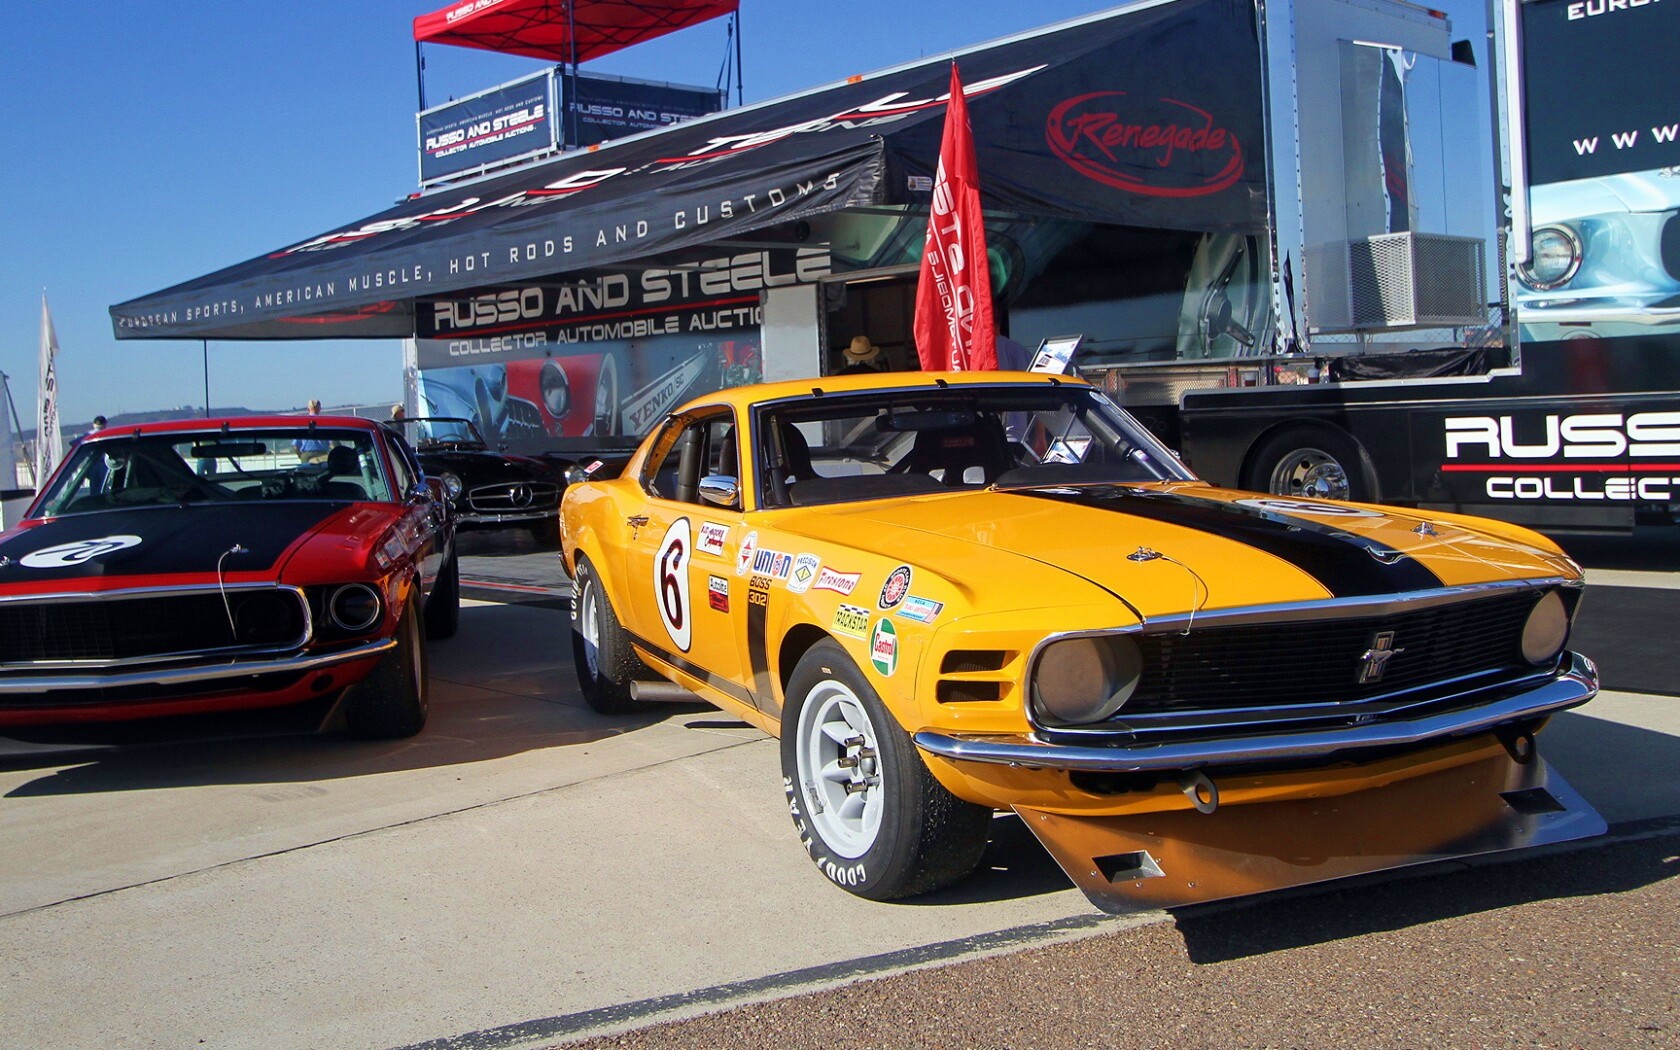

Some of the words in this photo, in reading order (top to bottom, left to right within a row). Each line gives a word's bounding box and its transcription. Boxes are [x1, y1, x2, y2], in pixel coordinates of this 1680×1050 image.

[570, 102, 623, 117] RUSSO
[627, 109, 657, 121] AND
[426, 129, 465, 150] RUSSO
[467, 121, 491, 140] AND
[492, 104, 544, 131] STEELE
[1067, 112, 1227, 167] Renegade
[435, 143, 468, 158] COLLECTOR
[469, 133, 505, 149] AUTOMOBILE
[186, 301, 245, 321] SPORTS,
[255, 282, 336, 309] AMERICAN
[349, 265, 433, 292] MUSCLE,
[449, 252, 491, 275] HOT
[509, 236, 574, 264] RODS
[596, 220, 649, 248] AND
[674, 172, 841, 231] CUSTOMS
[434, 286, 544, 331] RUSSO
[556, 273, 630, 316] AND
[641, 241, 832, 303] STEELE
[449, 330, 548, 358] COLLECTOR
[557, 315, 680, 345] AUTOMOBILE
[660, 538, 684, 631] 6
[749, 576, 773, 590] BOSS
[819, 571, 856, 591] Firestone
[748, 591, 768, 607] 302
[833, 610, 869, 633] TRACKSTAR
[874, 632, 894, 656] Castrol
